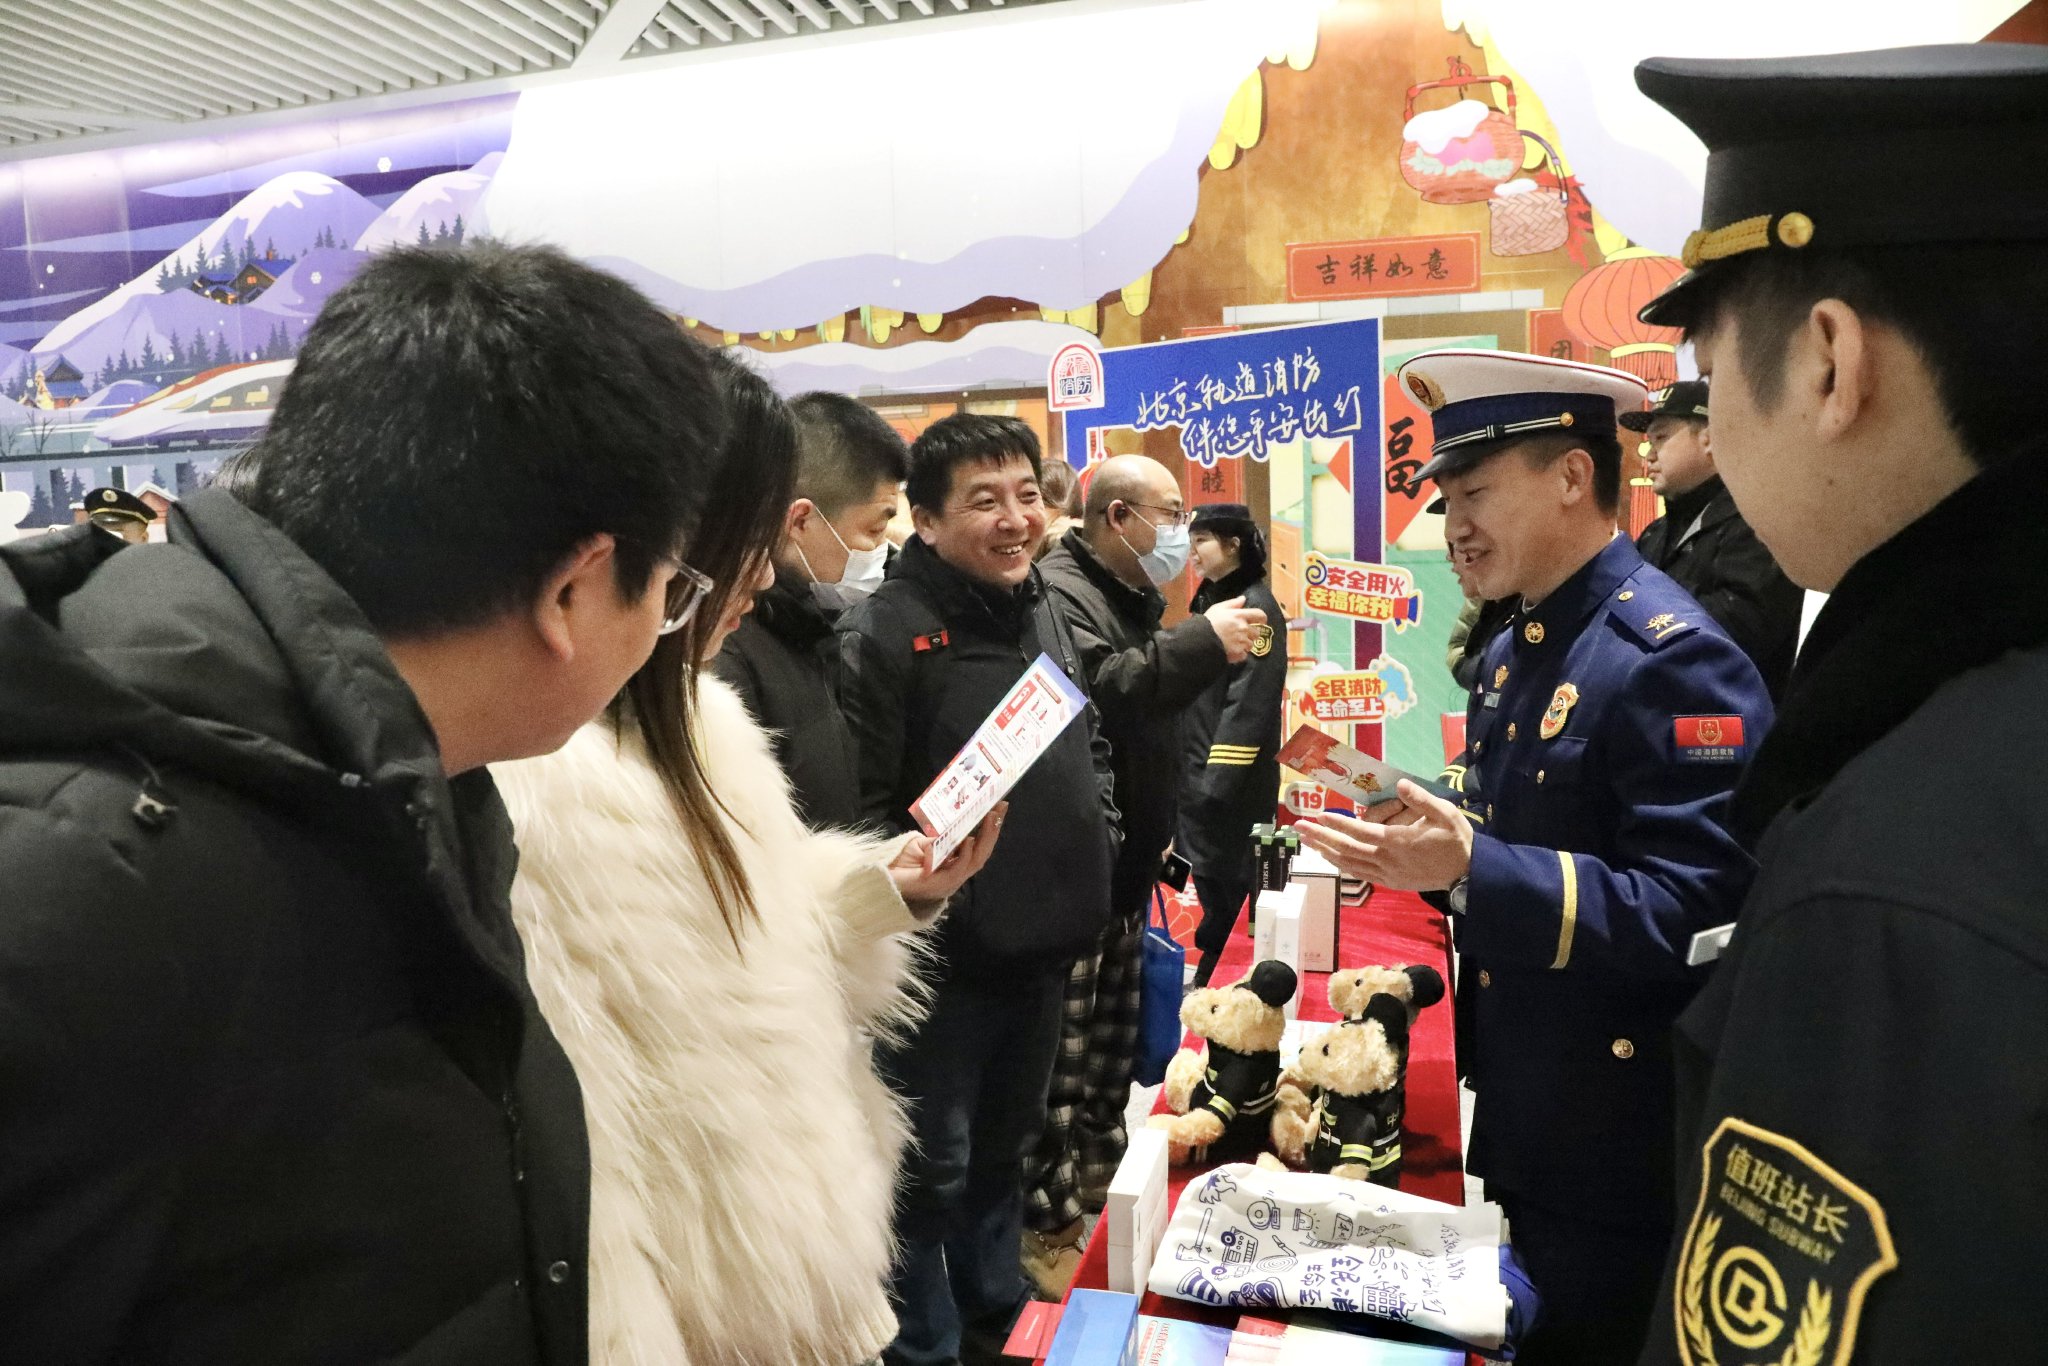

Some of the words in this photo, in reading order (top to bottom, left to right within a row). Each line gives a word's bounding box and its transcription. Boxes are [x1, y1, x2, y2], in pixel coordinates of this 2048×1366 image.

[1315, 247, 1449, 286] 吉祥如意
[1059, 375, 1092, 396] 消防
[1136, 346, 1322, 425] 北京轨道消防
[1184, 385, 1362, 461] 伴您平安出行
[1202, 466, 1226, 494] 睦
[1327, 566, 1405, 596] 安全用火
[1308, 585, 1392, 618] 幸福你我
[1314, 678, 1382, 698] 全民消防
[1315, 698, 1384, 718] 生命至上
[1290, 790, 1323, 810] 119
[1725, 1143, 1850, 1244] 值班站长
